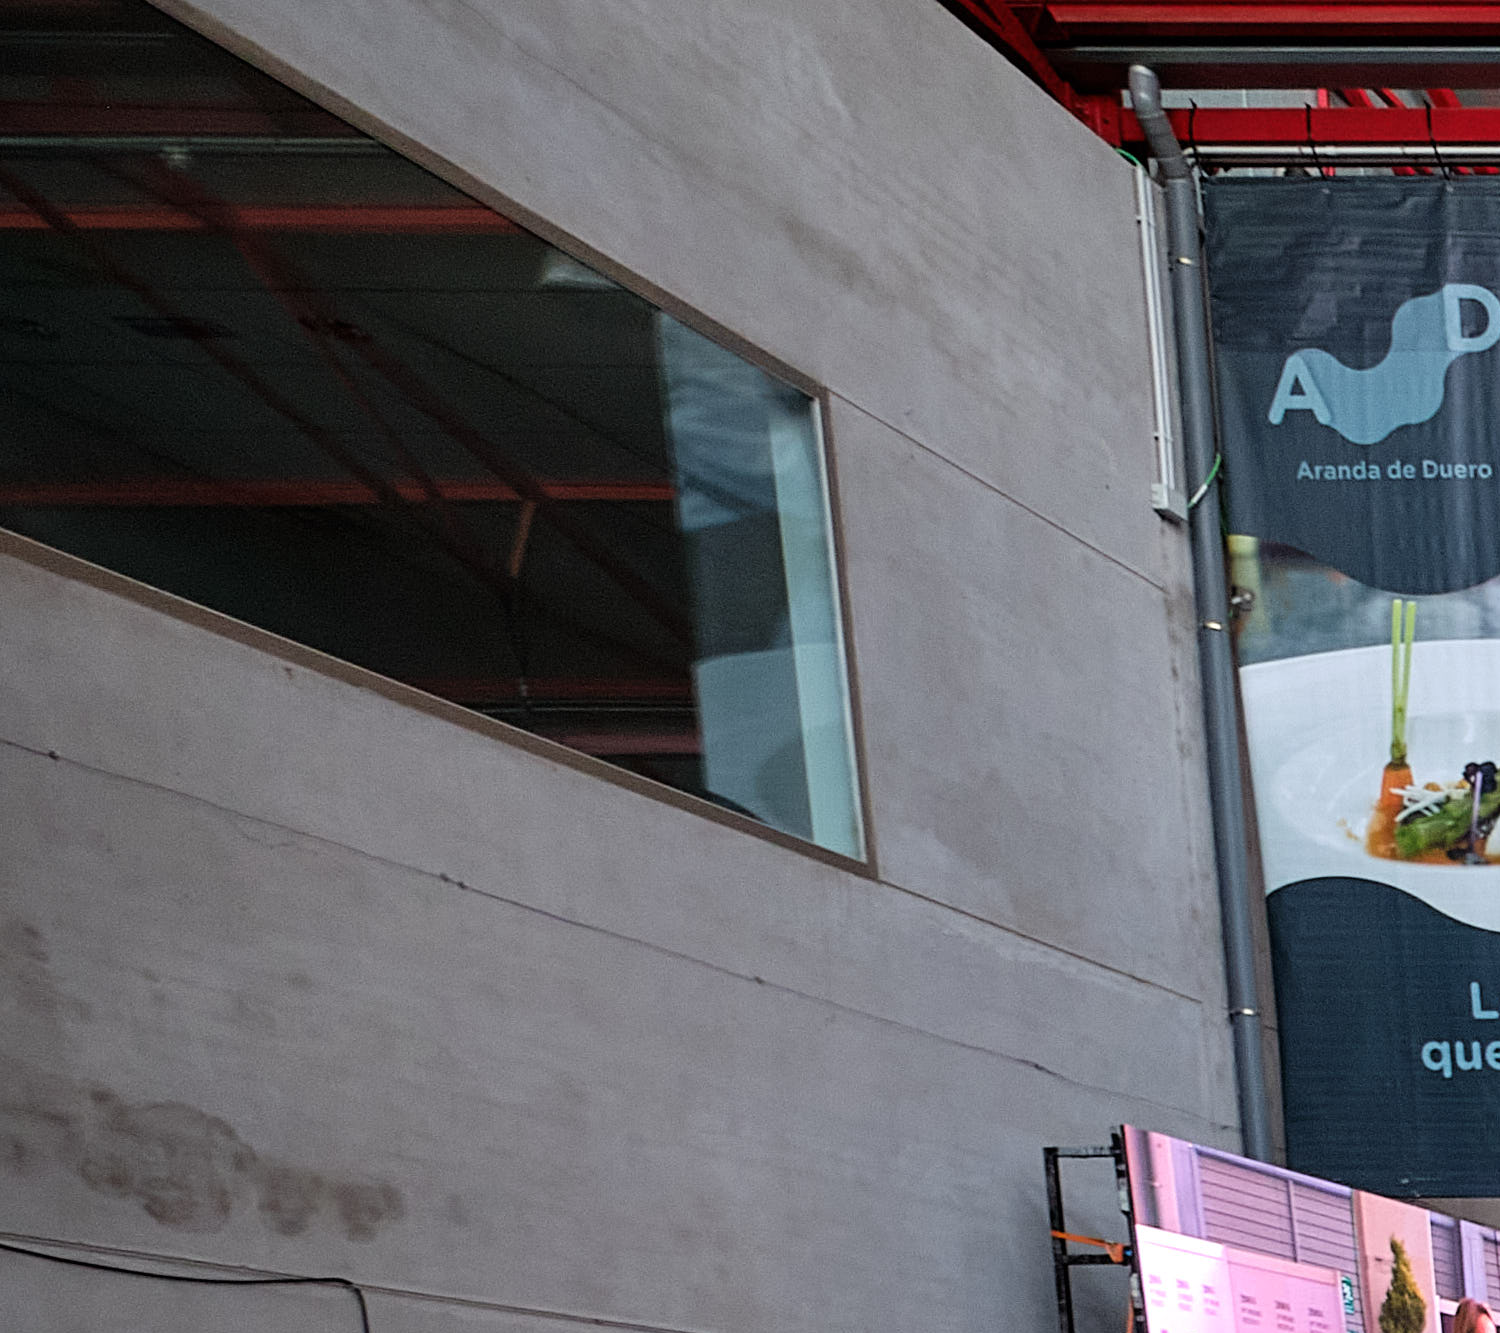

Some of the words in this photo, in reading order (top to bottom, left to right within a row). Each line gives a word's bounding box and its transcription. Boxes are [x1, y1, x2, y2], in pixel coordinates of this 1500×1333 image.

[1297, 459, 1381, 482] Aranda
[1396, 459, 1417, 481] de
[1421, 459, 1493, 482] Duero
